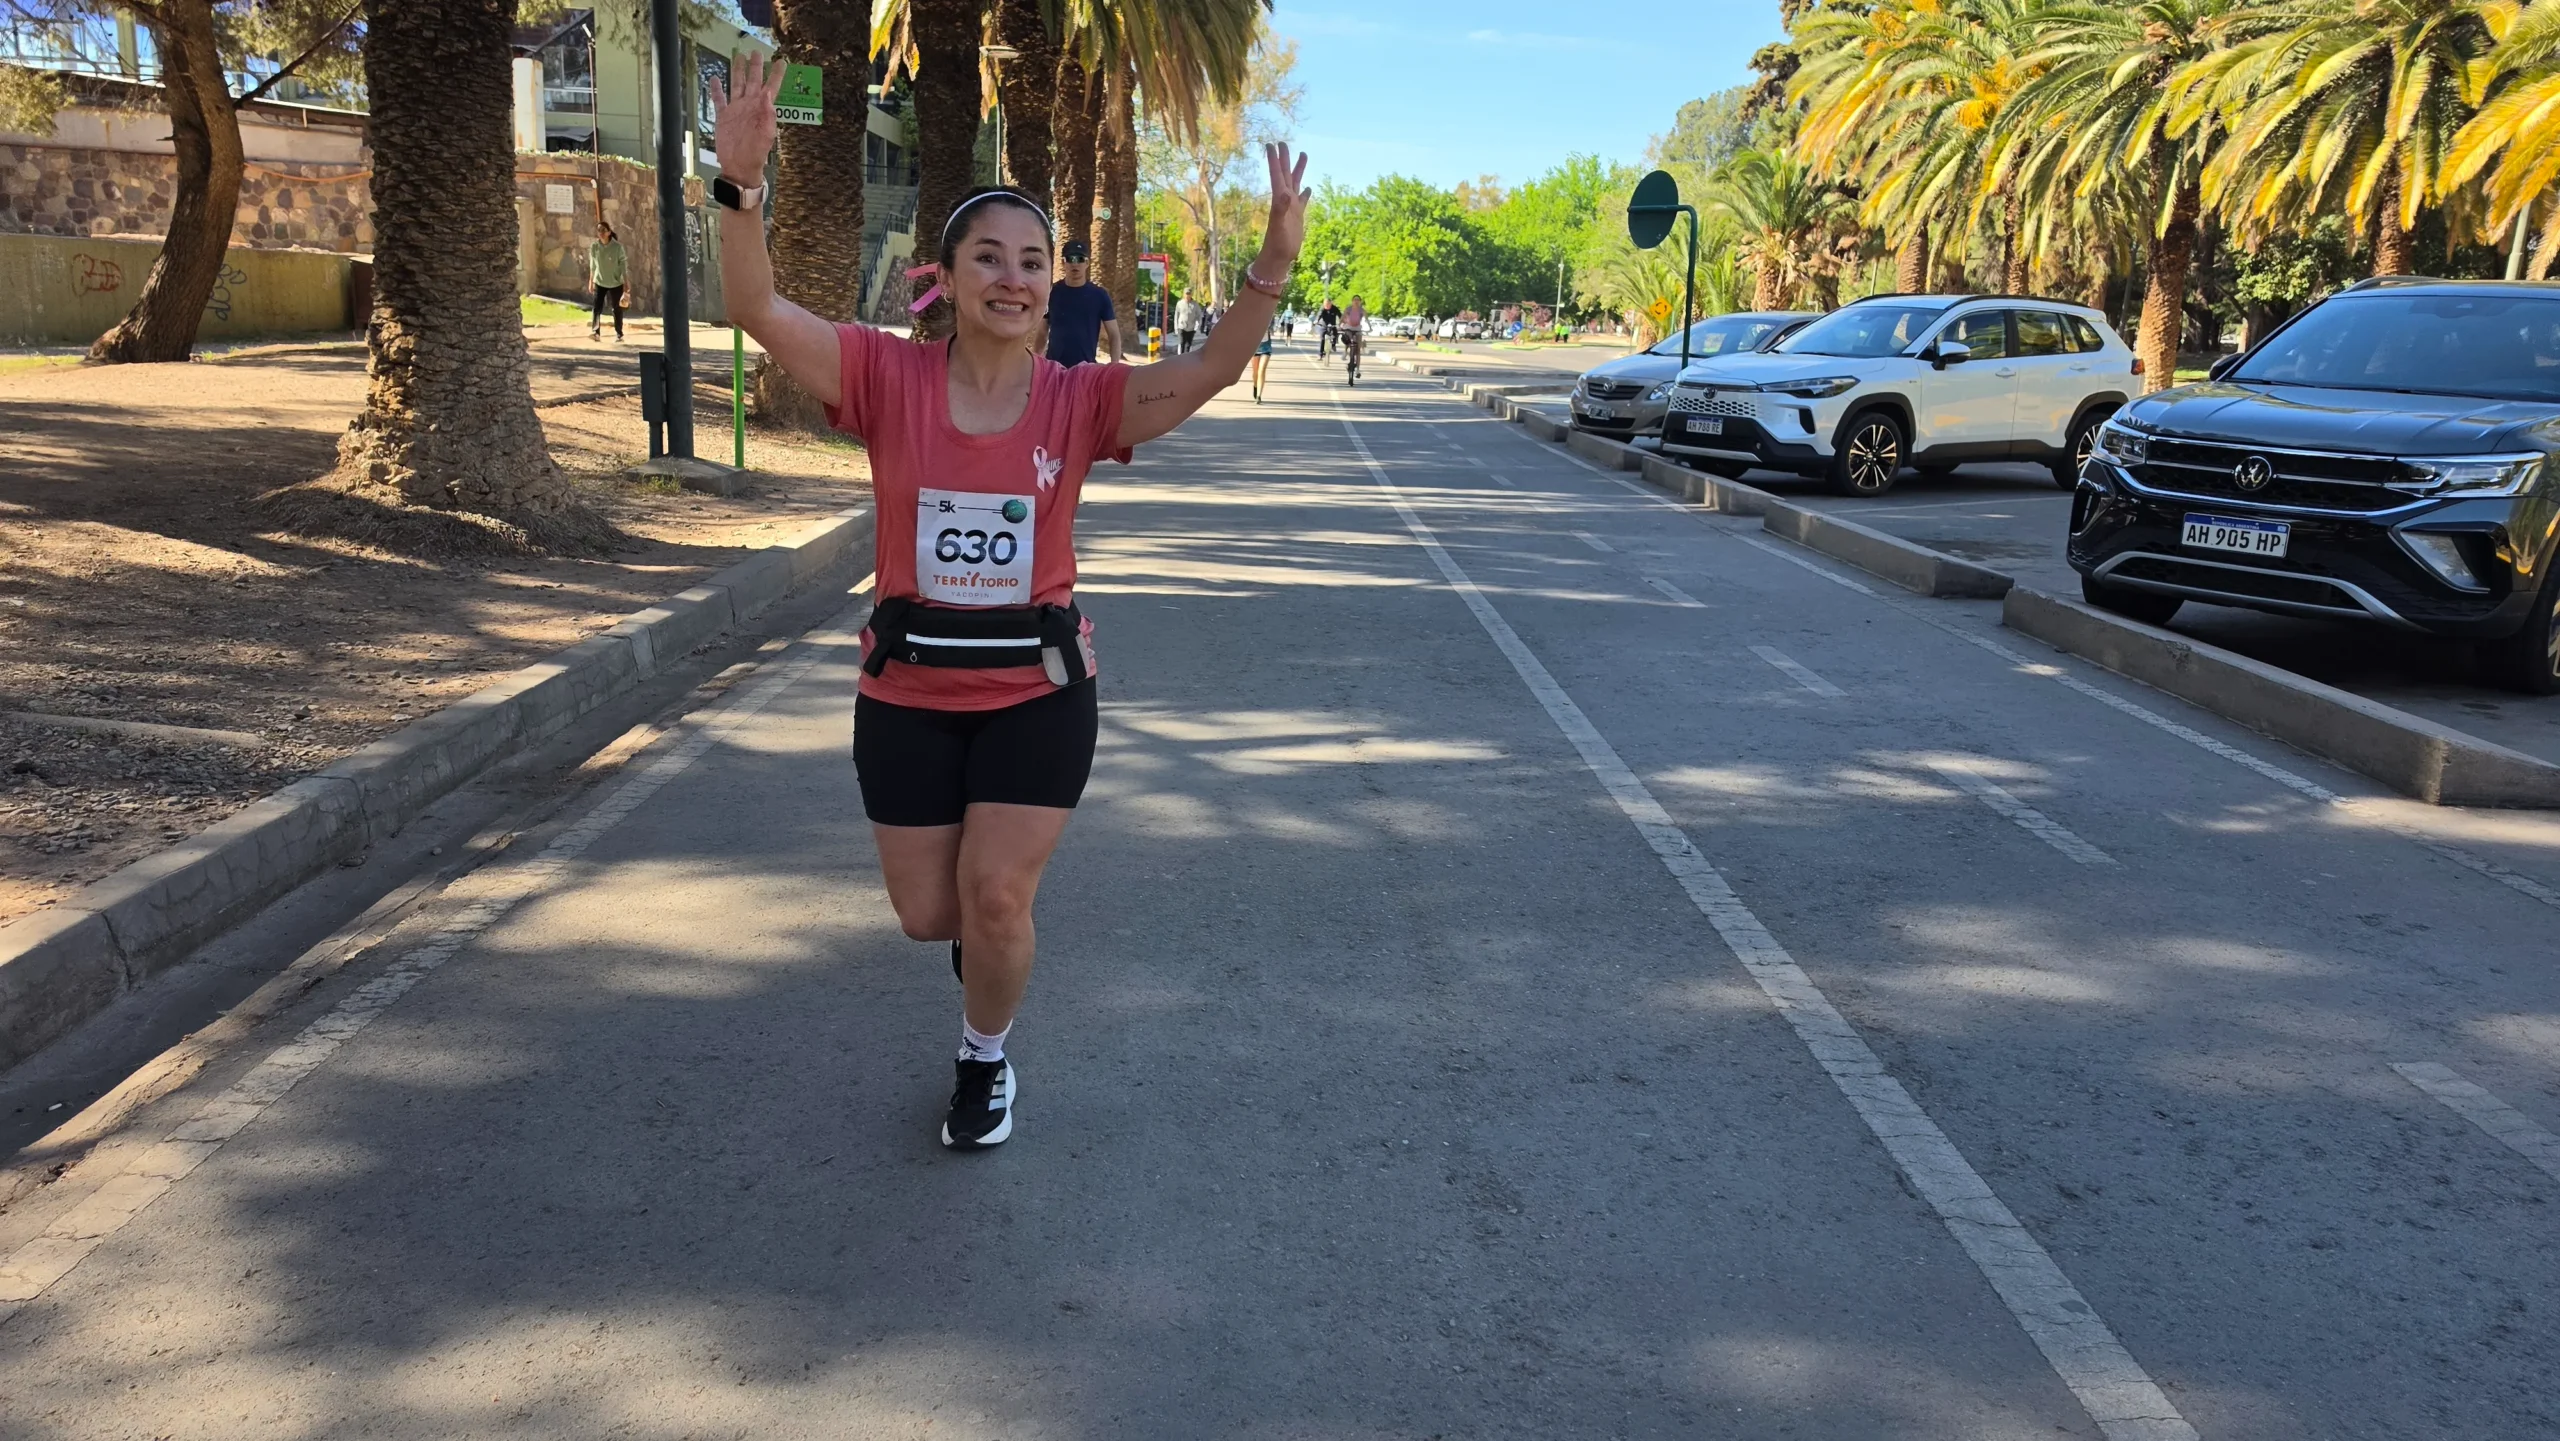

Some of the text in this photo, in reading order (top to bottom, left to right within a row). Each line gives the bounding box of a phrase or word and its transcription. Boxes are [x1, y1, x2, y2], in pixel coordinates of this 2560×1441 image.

[803, 111, 814, 121] m
[1688, 421, 1697, 431] AH
[1711, 423, 1720, 434] RE
[1045, 458, 1062, 471] NIKE
[939, 500, 956, 514] 5k
[2186, 524, 2281, 552] AH 905 HP
[935, 528, 1018, 566] 630
[951, 591, 993, 599] YACOPINI
